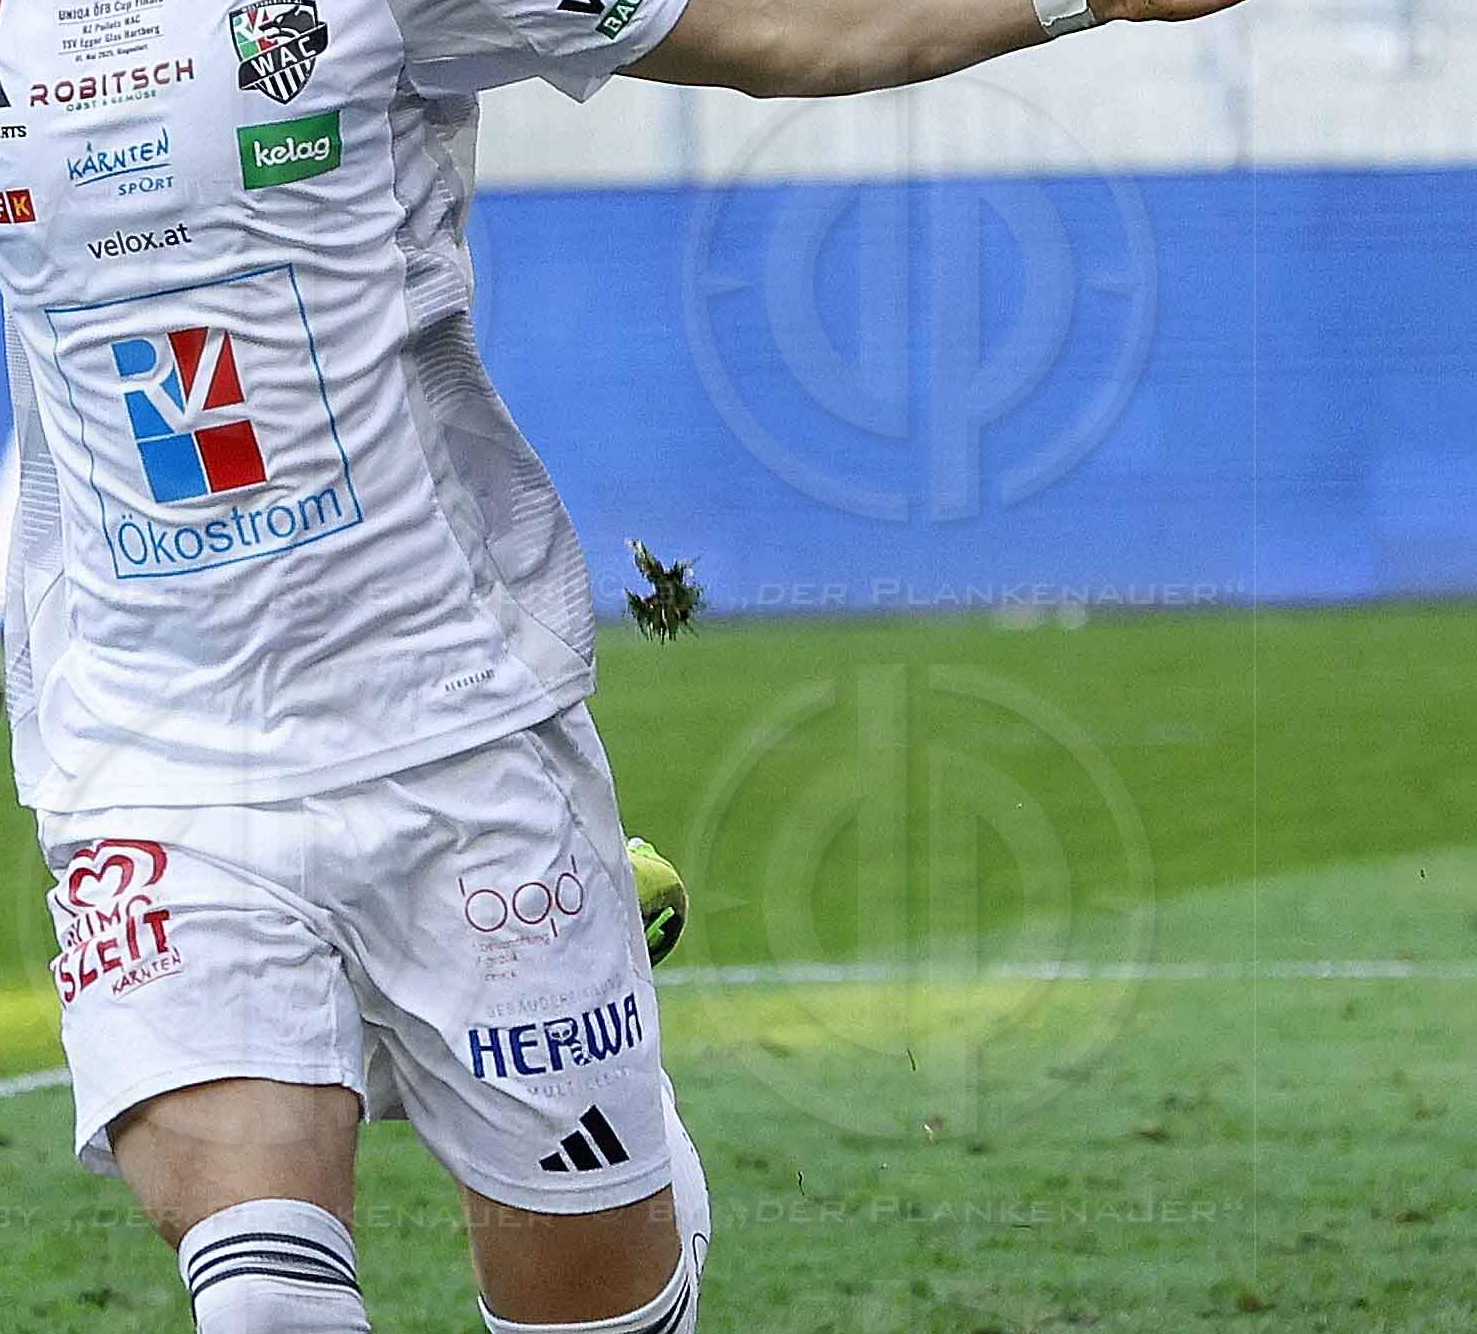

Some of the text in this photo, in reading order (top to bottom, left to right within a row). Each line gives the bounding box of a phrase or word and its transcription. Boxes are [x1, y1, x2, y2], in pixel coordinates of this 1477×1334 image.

[114, 0, 132, 12] Cup
[250, 35, 317, 77] WAC
[29, 58, 196, 107] ROBITSCH
[253, 136, 330, 167] kelag
[117, 175, 175, 196] SPORT
[14, 196, 30, 217] K
[87, 222, 193, 260] velox.at
[119, 484, 345, 567] Ökostrom
[55, 909, 171, 1007] SZEIT
[468, 992, 643, 1080] HERWA
